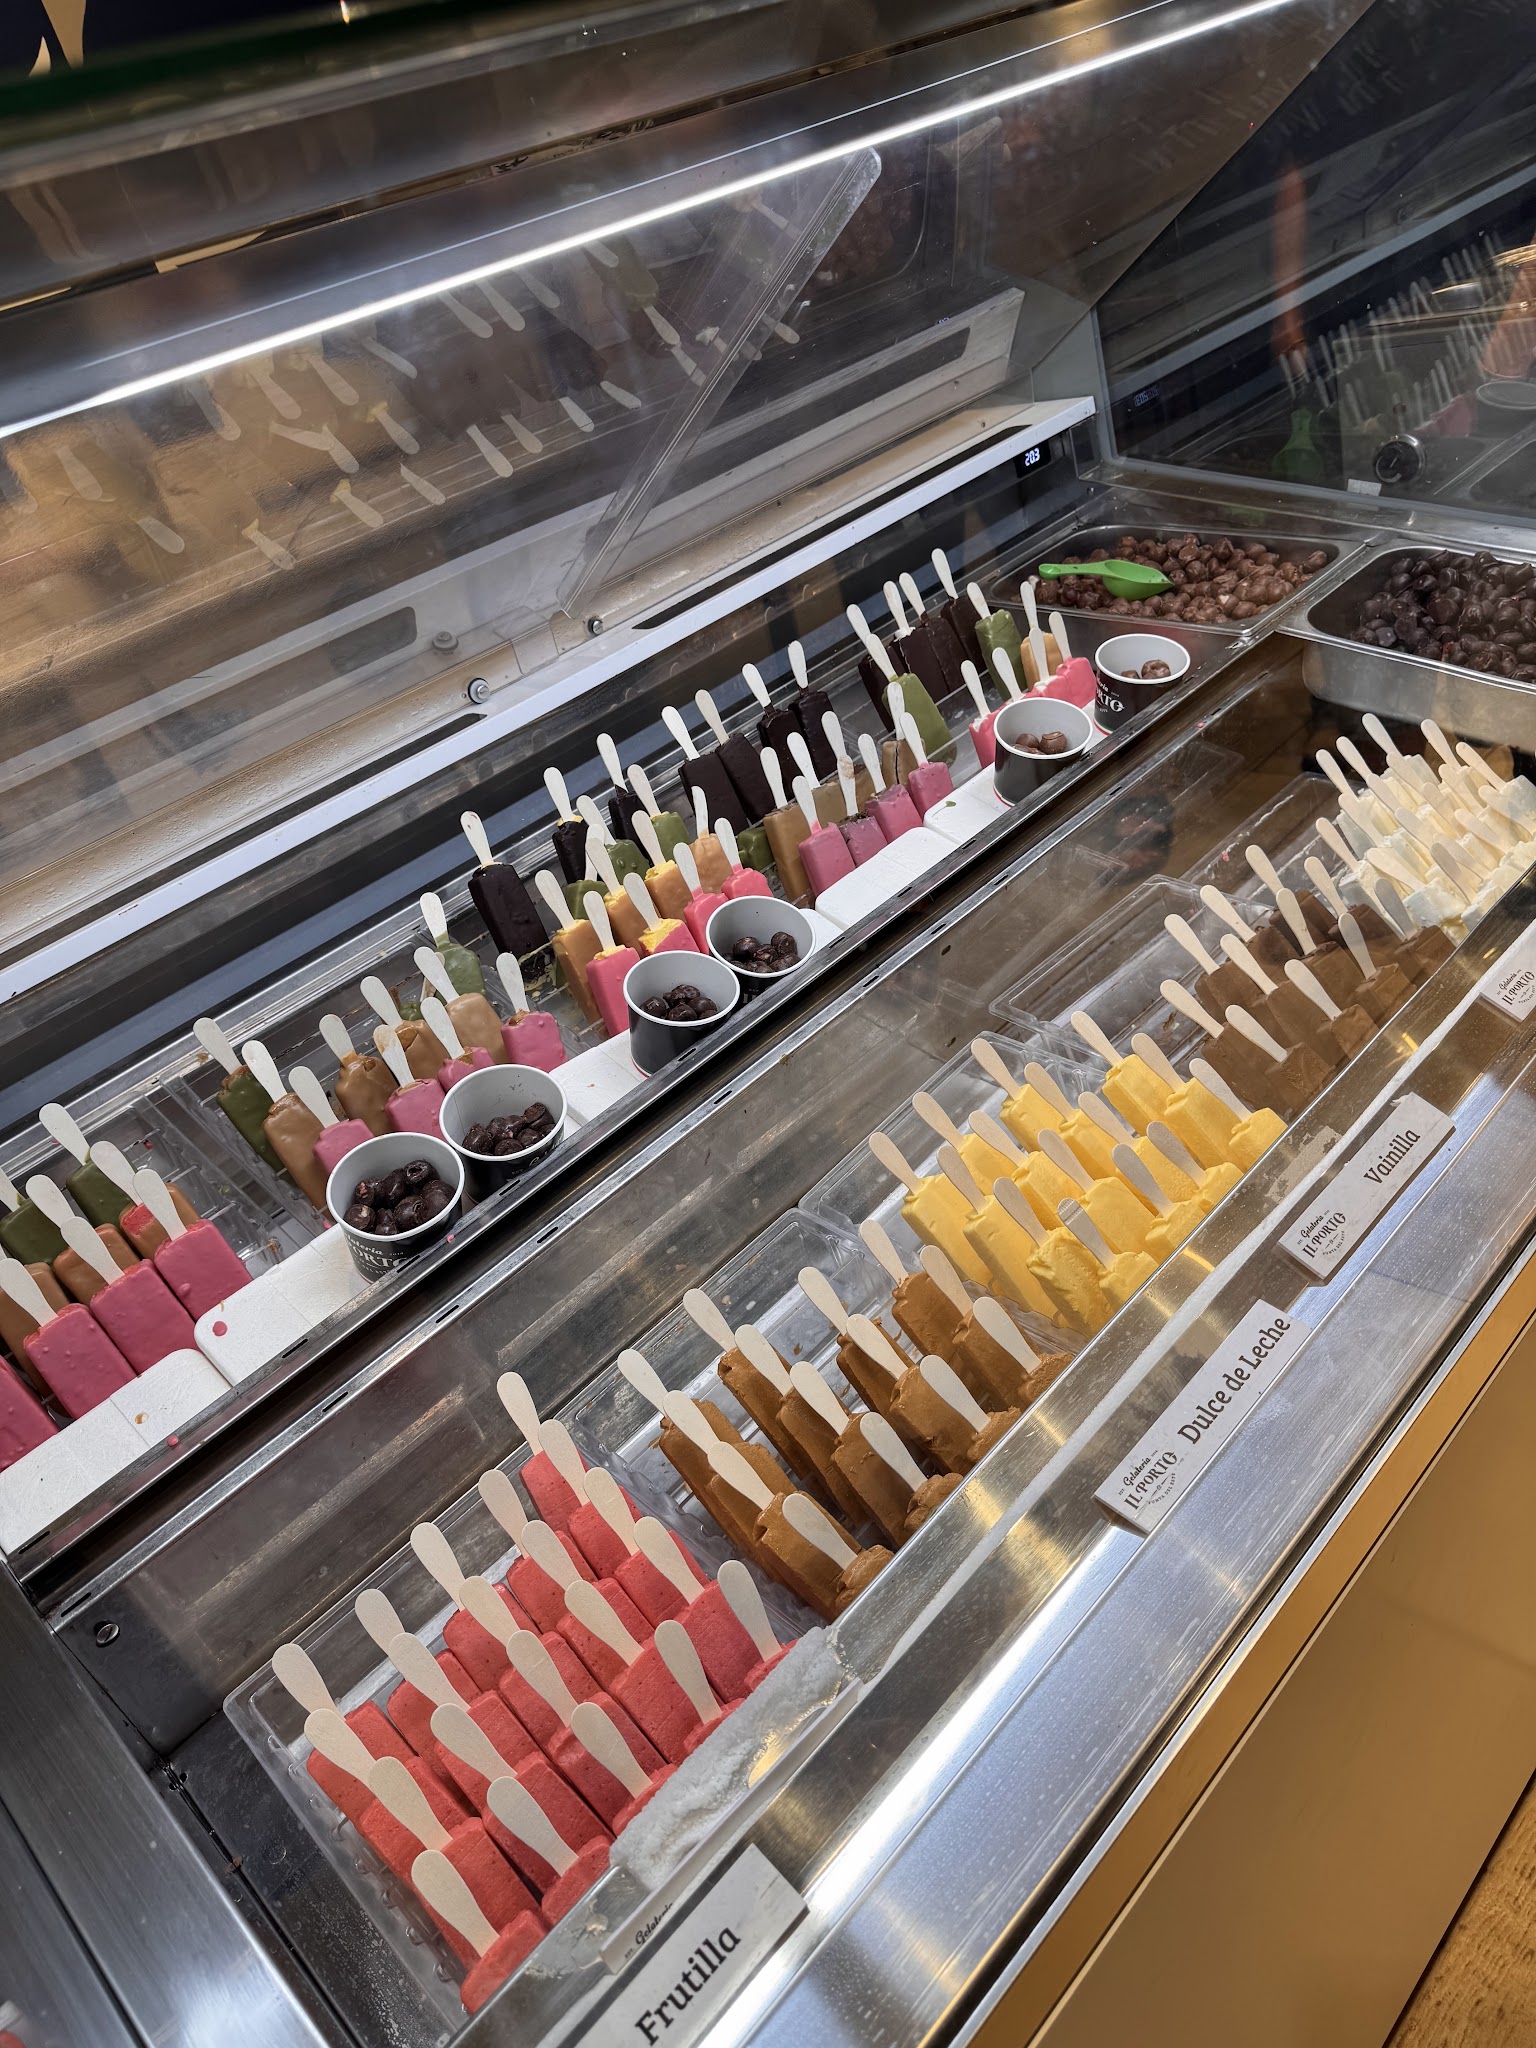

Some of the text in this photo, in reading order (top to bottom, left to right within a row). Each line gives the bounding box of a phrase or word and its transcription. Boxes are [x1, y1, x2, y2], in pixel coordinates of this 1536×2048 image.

[1502, 994, 1515, 1005] IL
[1508, 971, 1535, 996] PORTO
[1363, 1129, 1421, 1184] Vainilla
[1300, 1215, 1324, 1238] Gelateria
[1302, 1212, 1346, 1258] IL PORTO
[1176, 1318, 1291, 1445] Dulce de Leche
[1123, 1457, 1152, 1487] Gelateria
[1123, 1451, 1177, 1510] IL PORTO
[634, 1926, 742, 2046] Frutilla
